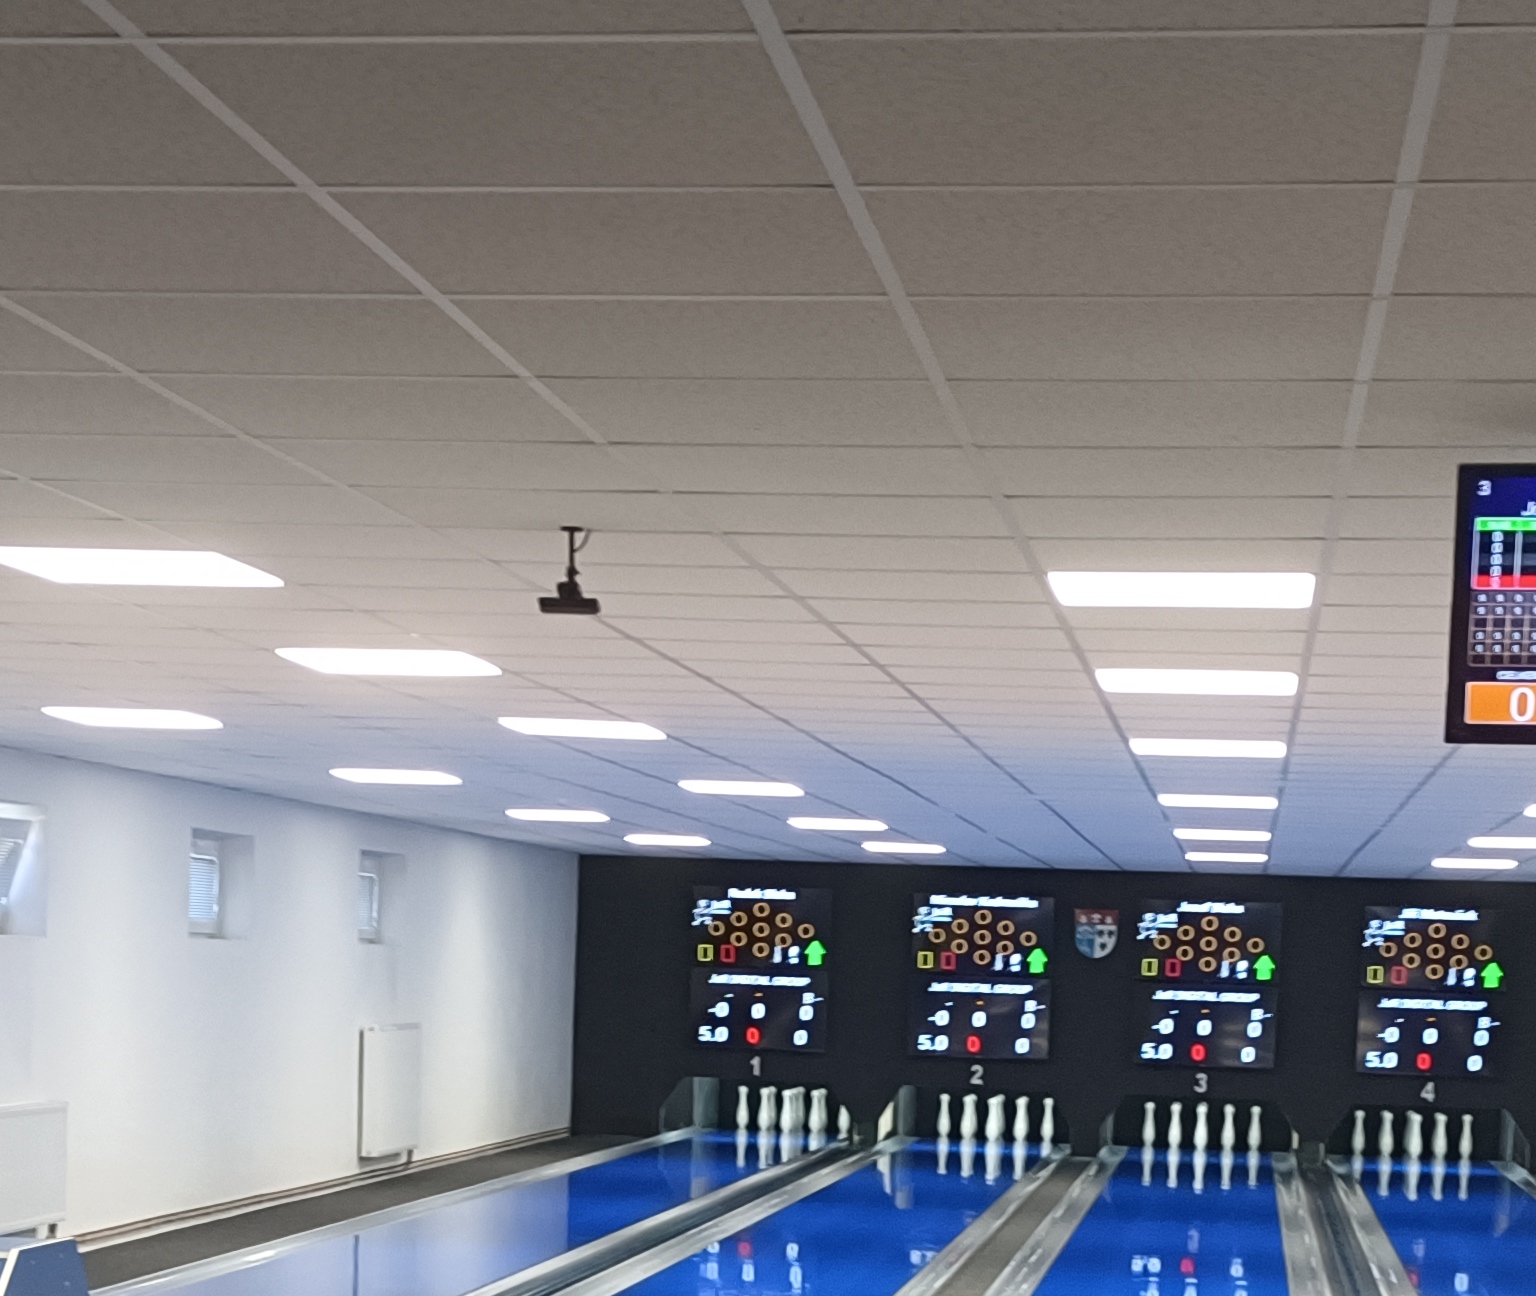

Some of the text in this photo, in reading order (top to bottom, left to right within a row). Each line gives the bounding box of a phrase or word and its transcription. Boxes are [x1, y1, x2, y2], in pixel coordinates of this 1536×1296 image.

[1476, 480, 1492, 496] 3
[1509, 686, 1536, 722] 0
[750, 1056, 761, 1076] 1
[969, 1064, 984, 1085] 2
[1193, 1072, 1208, 1093] 3
[1420, 1081, 1435, 1102] 4
